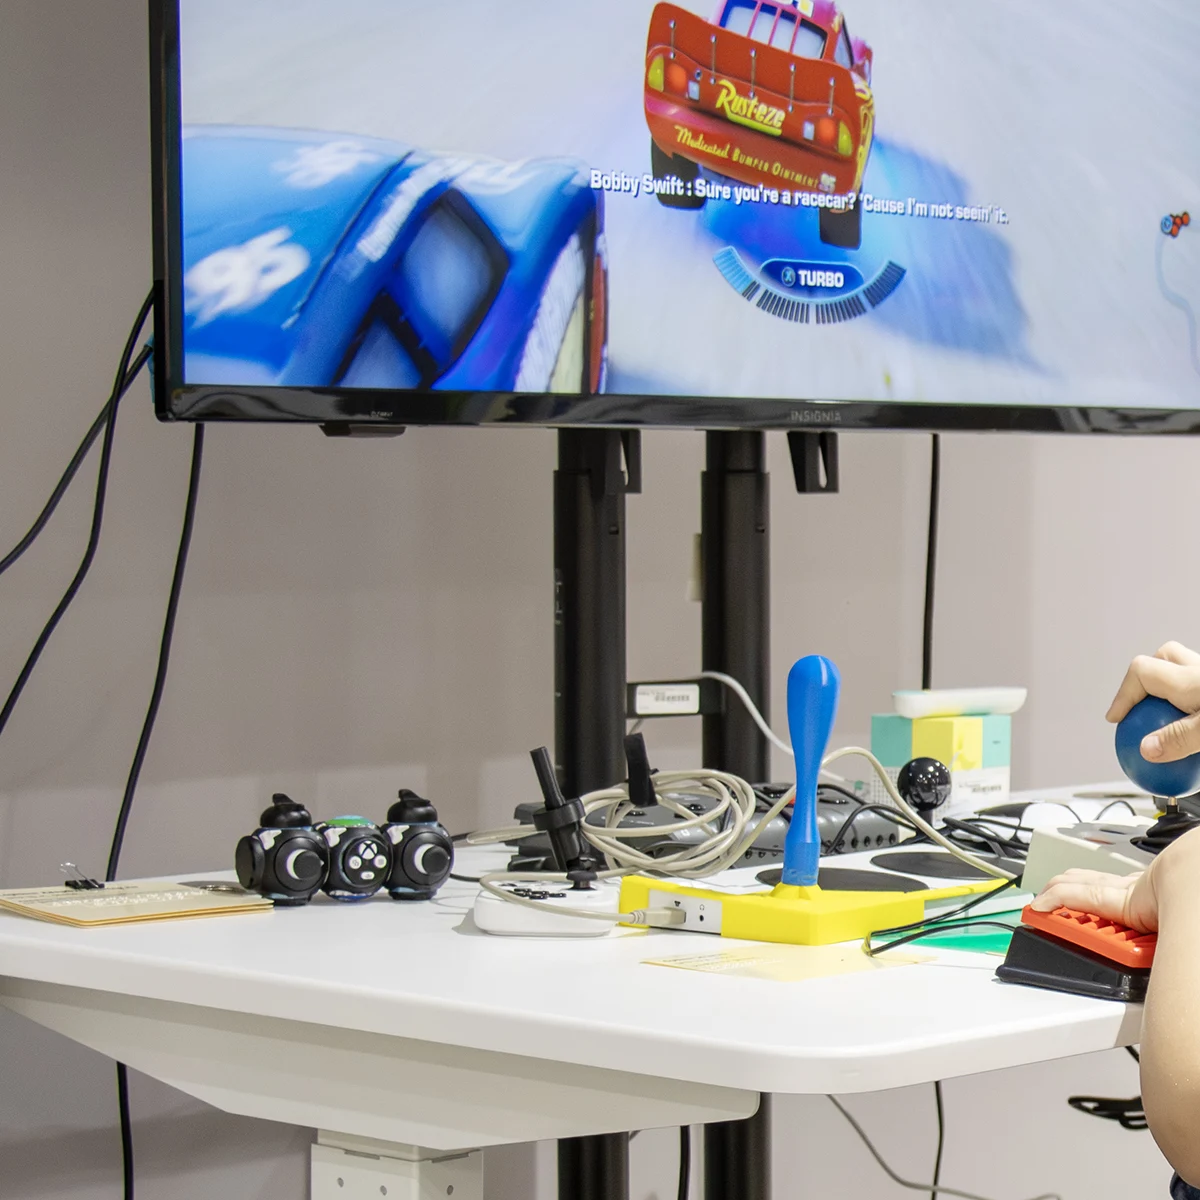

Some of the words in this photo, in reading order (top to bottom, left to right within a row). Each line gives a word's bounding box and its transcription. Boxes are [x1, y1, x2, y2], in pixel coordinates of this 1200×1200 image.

[674, 124, 730, 159] Medicated
[590, 169, 640, 197] Bobby
[641, 174, 685, 196] Swift
[694, 180, 731, 199] Sure
[734, 184, 780, 206] you're
[782, 190, 792, 204] a
[794, 192, 857, 210] racecar?
[860, 193, 905, 214] 'Cause
[907, 197, 928, 216] I'm
[931, 202, 953, 218] not
[956, 204, 994, 222] seein'
[995, 206, 1010, 224] it.
[798, 269, 845, 288] TURBO
[791, 410, 842, 421] INSIGNIA
